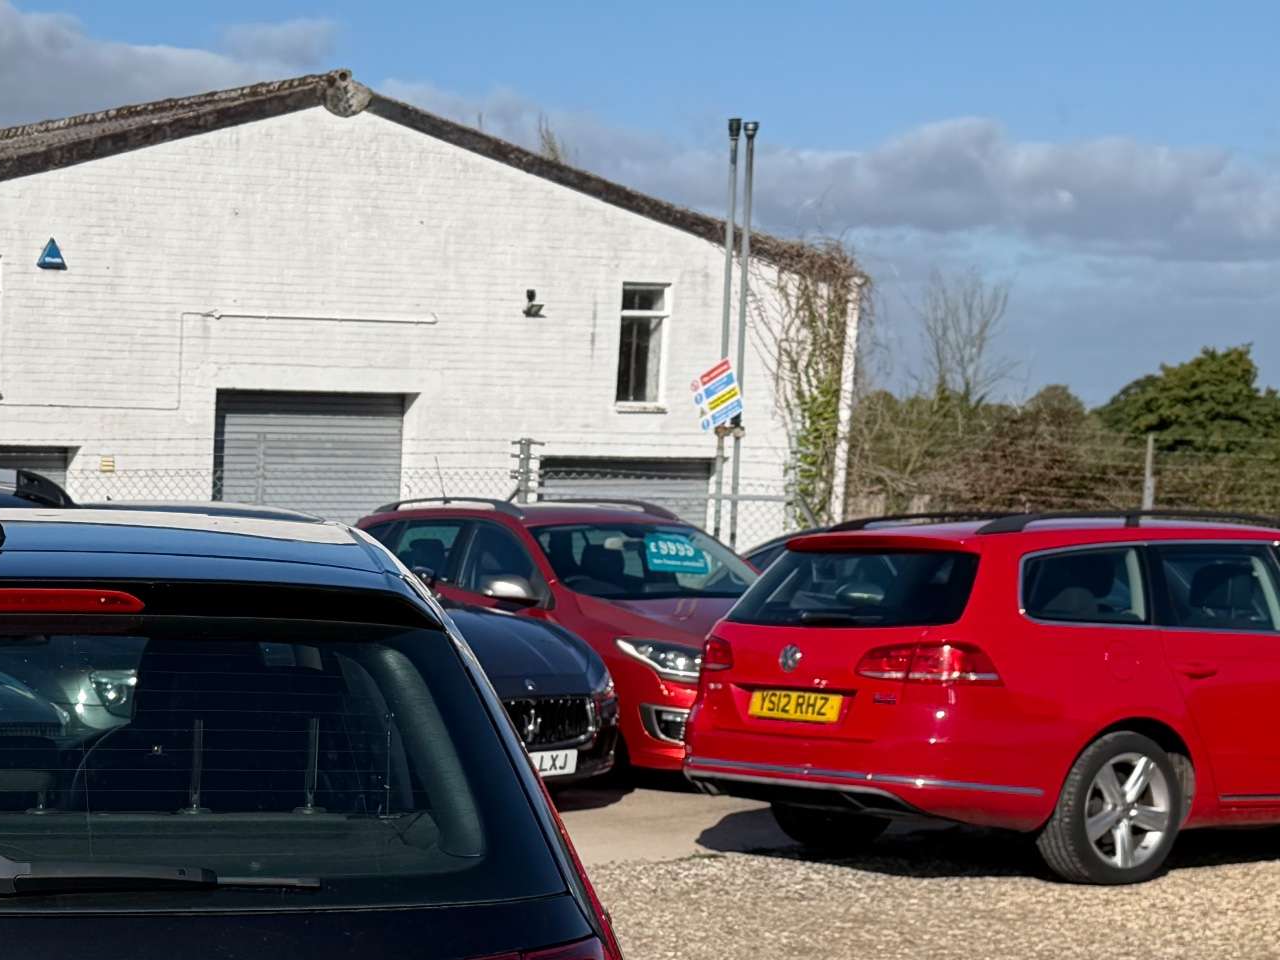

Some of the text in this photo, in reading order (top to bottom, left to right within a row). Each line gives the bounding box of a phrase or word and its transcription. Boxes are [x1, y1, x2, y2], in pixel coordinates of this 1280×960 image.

[759, 690, 830, 717] YS12 RHZ
[538, 753, 569, 772] LXJ
